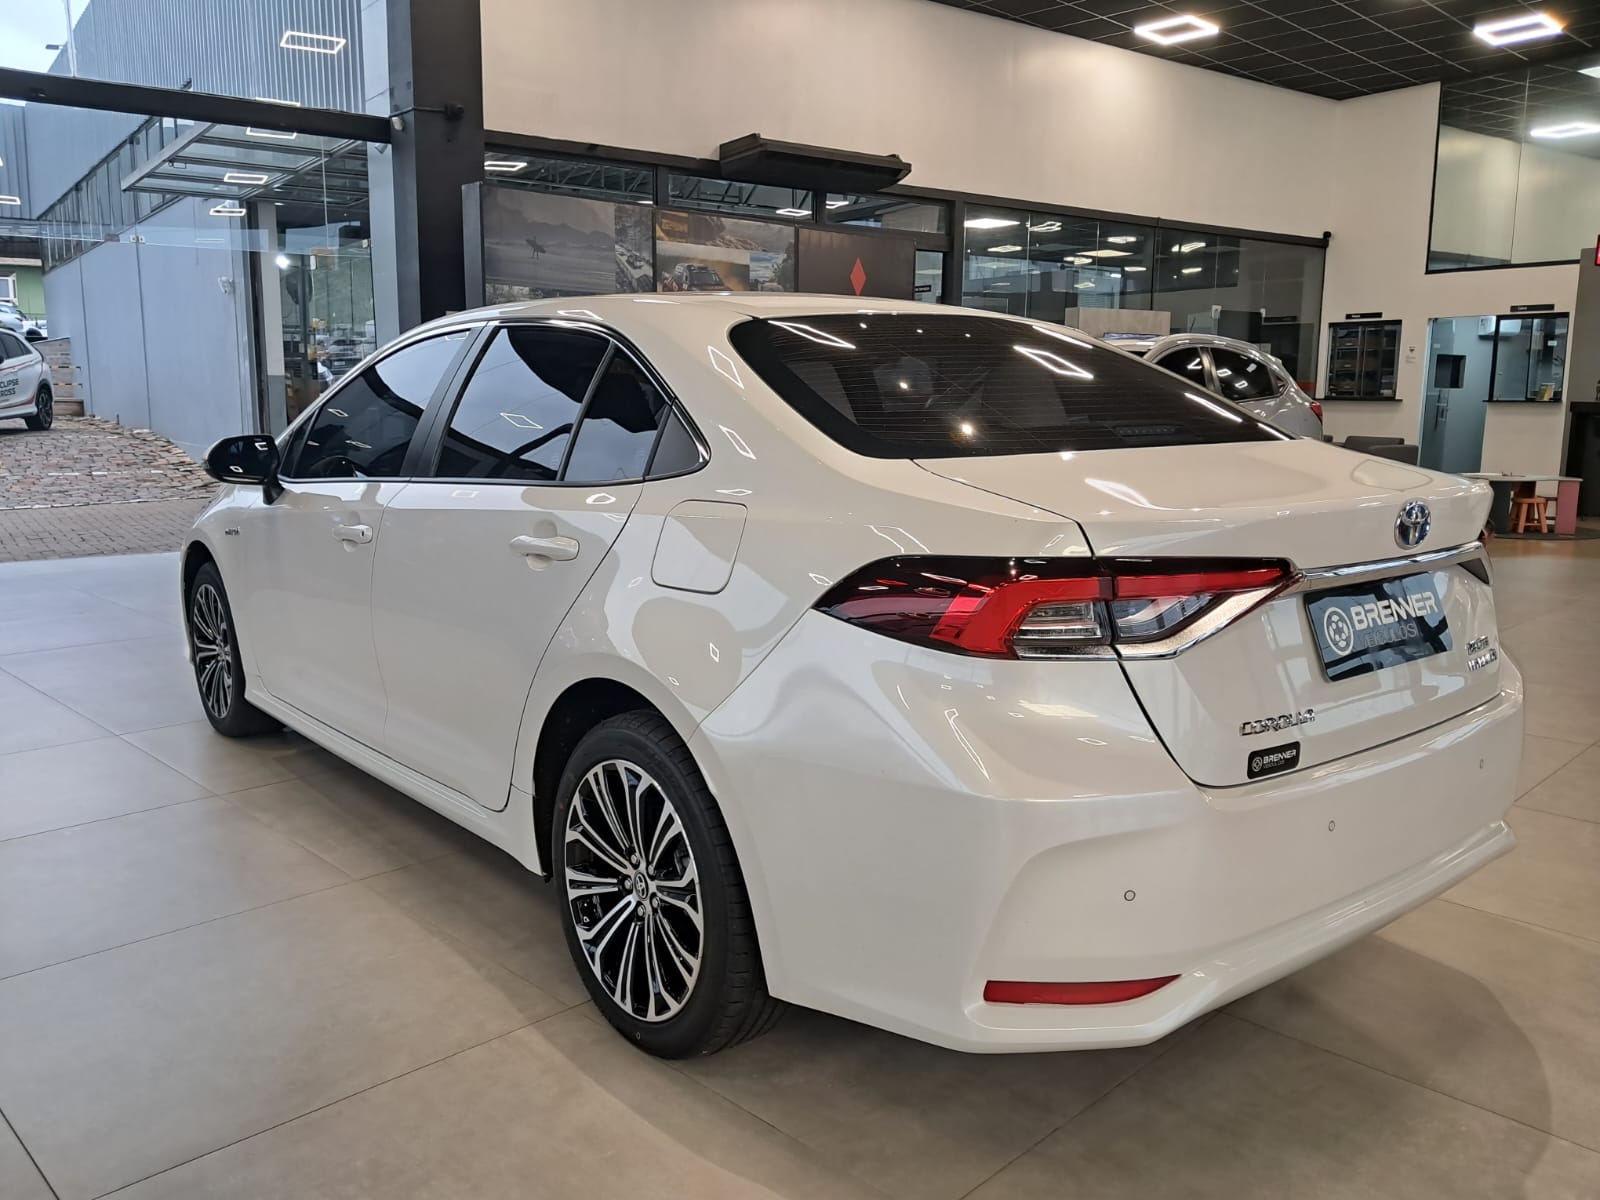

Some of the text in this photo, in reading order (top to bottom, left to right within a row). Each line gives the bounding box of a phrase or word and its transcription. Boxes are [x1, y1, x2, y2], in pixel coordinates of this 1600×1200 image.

[1350, 591, 1439, 631] BRENNER
[1239, 708, 1316, 736] COROLLA
[1263, 749, 1297, 764] BRENNER
